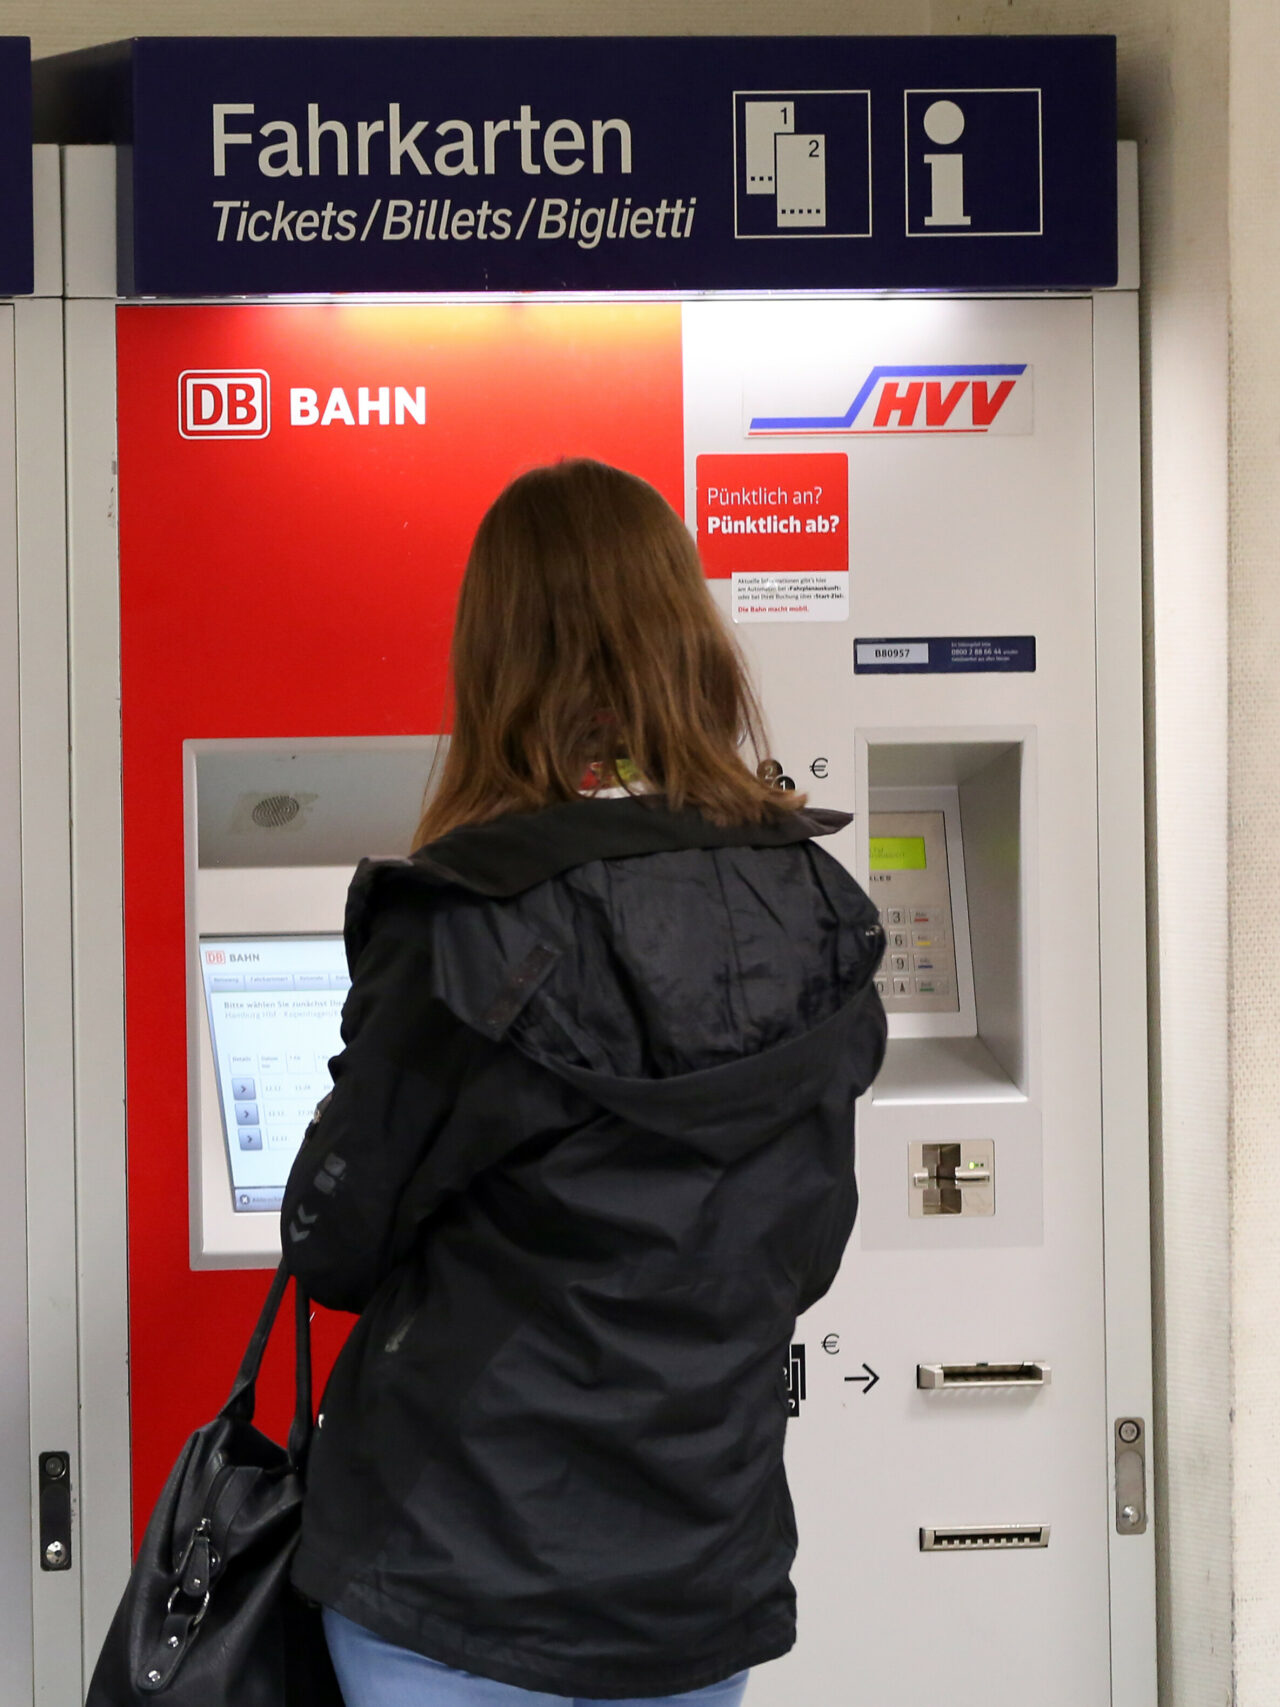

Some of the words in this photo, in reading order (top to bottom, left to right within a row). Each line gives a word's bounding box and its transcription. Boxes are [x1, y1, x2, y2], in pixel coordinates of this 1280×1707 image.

[780, 107, 789, 125] 1
[212, 102, 632, 177] Fahrkarten
[808, 140, 820, 158] 2
[189, 380, 260, 430] DB
[290, 386, 426, 426] BAHN
[873, 380, 1017, 427] HVV
[707, 486, 788, 506] Pünktlich
[792, 486, 823, 505] an?
[707, 515, 801, 534] Pünktlich
[805, 514, 840, 533] ab?
[875, 648, 910, 658] B80957
[764, 766, 774, 780] 2
[892, 911, 901, 924] 3
[894, 934, 903, 946] 6
[207, 951, 224, 964] DB
[229, 953, 260, 962] BAHN
[896, 958, 905, 970] 9
[224, 1001, 244, 1009] Bitte
